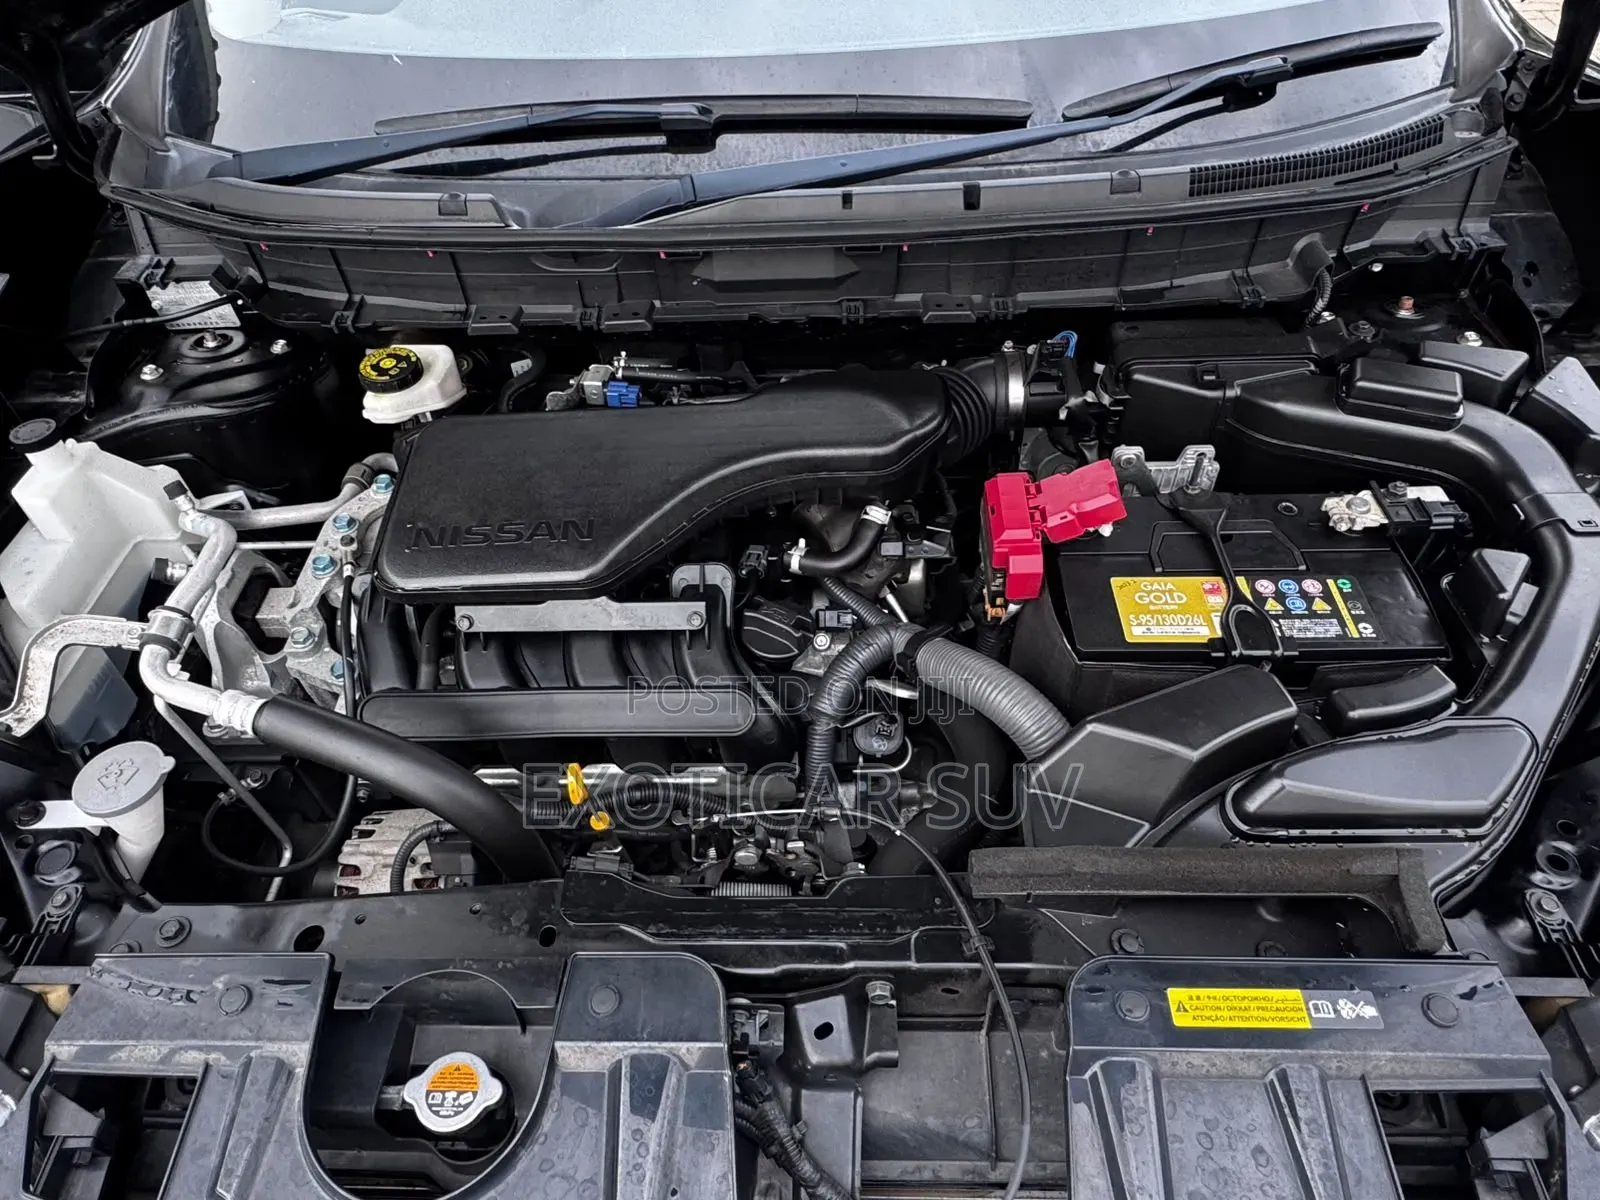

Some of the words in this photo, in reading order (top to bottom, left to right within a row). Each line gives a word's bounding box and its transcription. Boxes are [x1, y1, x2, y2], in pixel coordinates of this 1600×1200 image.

[411, 519, 595, 549] NISSAN
[1140, 581, 1176, 591] GAIA
[1134, 592, 1188, 604] GOLD
[1128, 613, 1208, 626] S-95/130D26L
[1189, 1004, 1222, 1012] CAUTION
